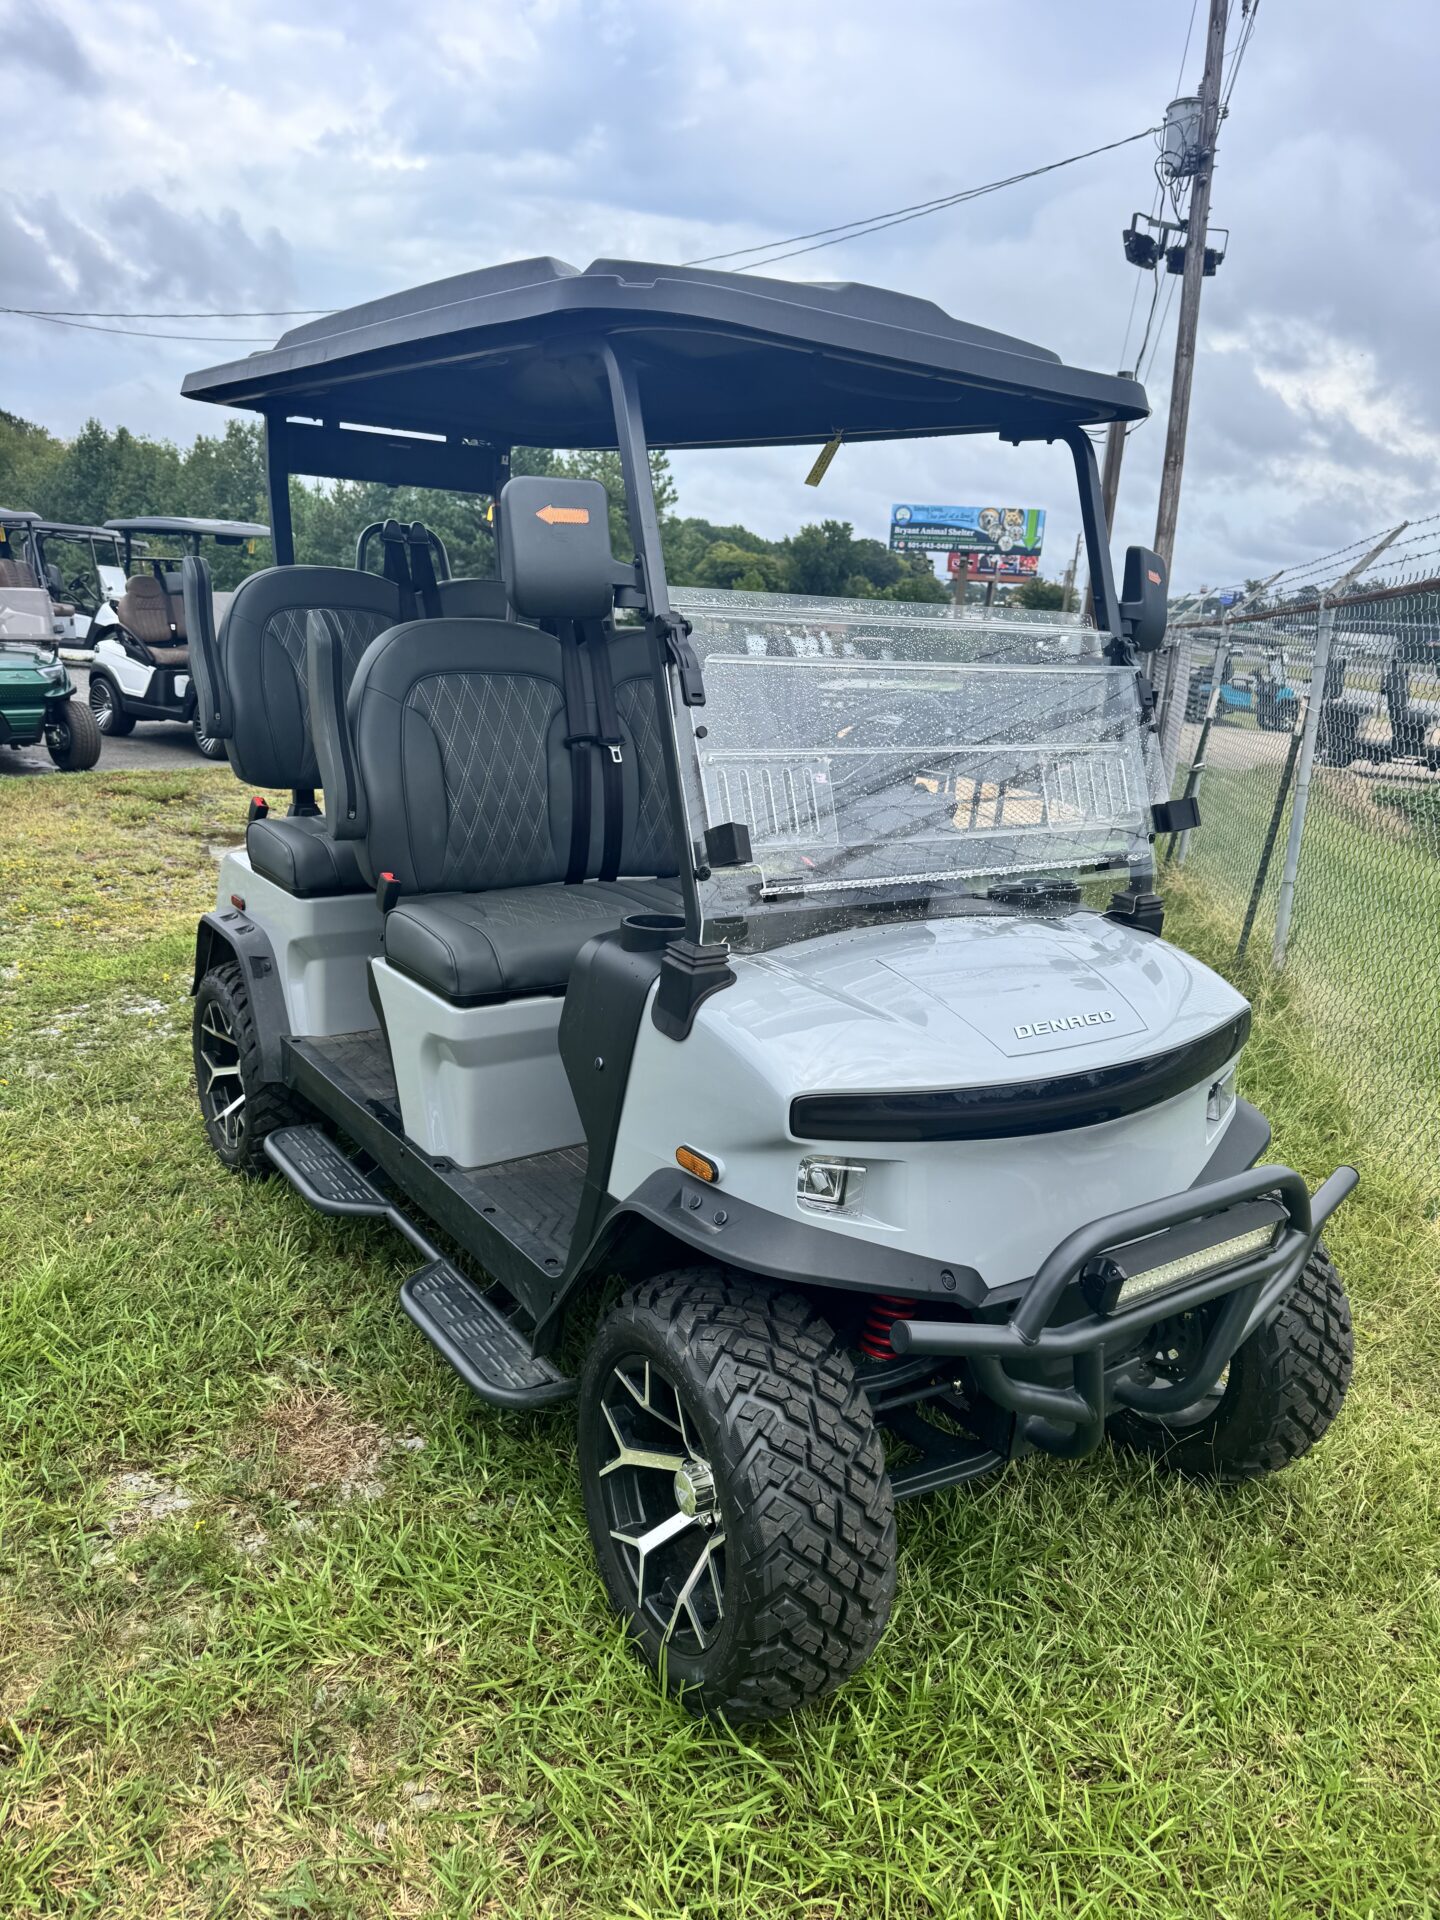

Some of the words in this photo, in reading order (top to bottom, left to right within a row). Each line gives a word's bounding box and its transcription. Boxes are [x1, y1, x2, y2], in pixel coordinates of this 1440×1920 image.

[894, 526, 919, 536] Bryant
[920, 527, 947, 535] Animal
[948, 528, 975, 537] Shelter
[1014, 1010, 1116, 1039] DENAGO
